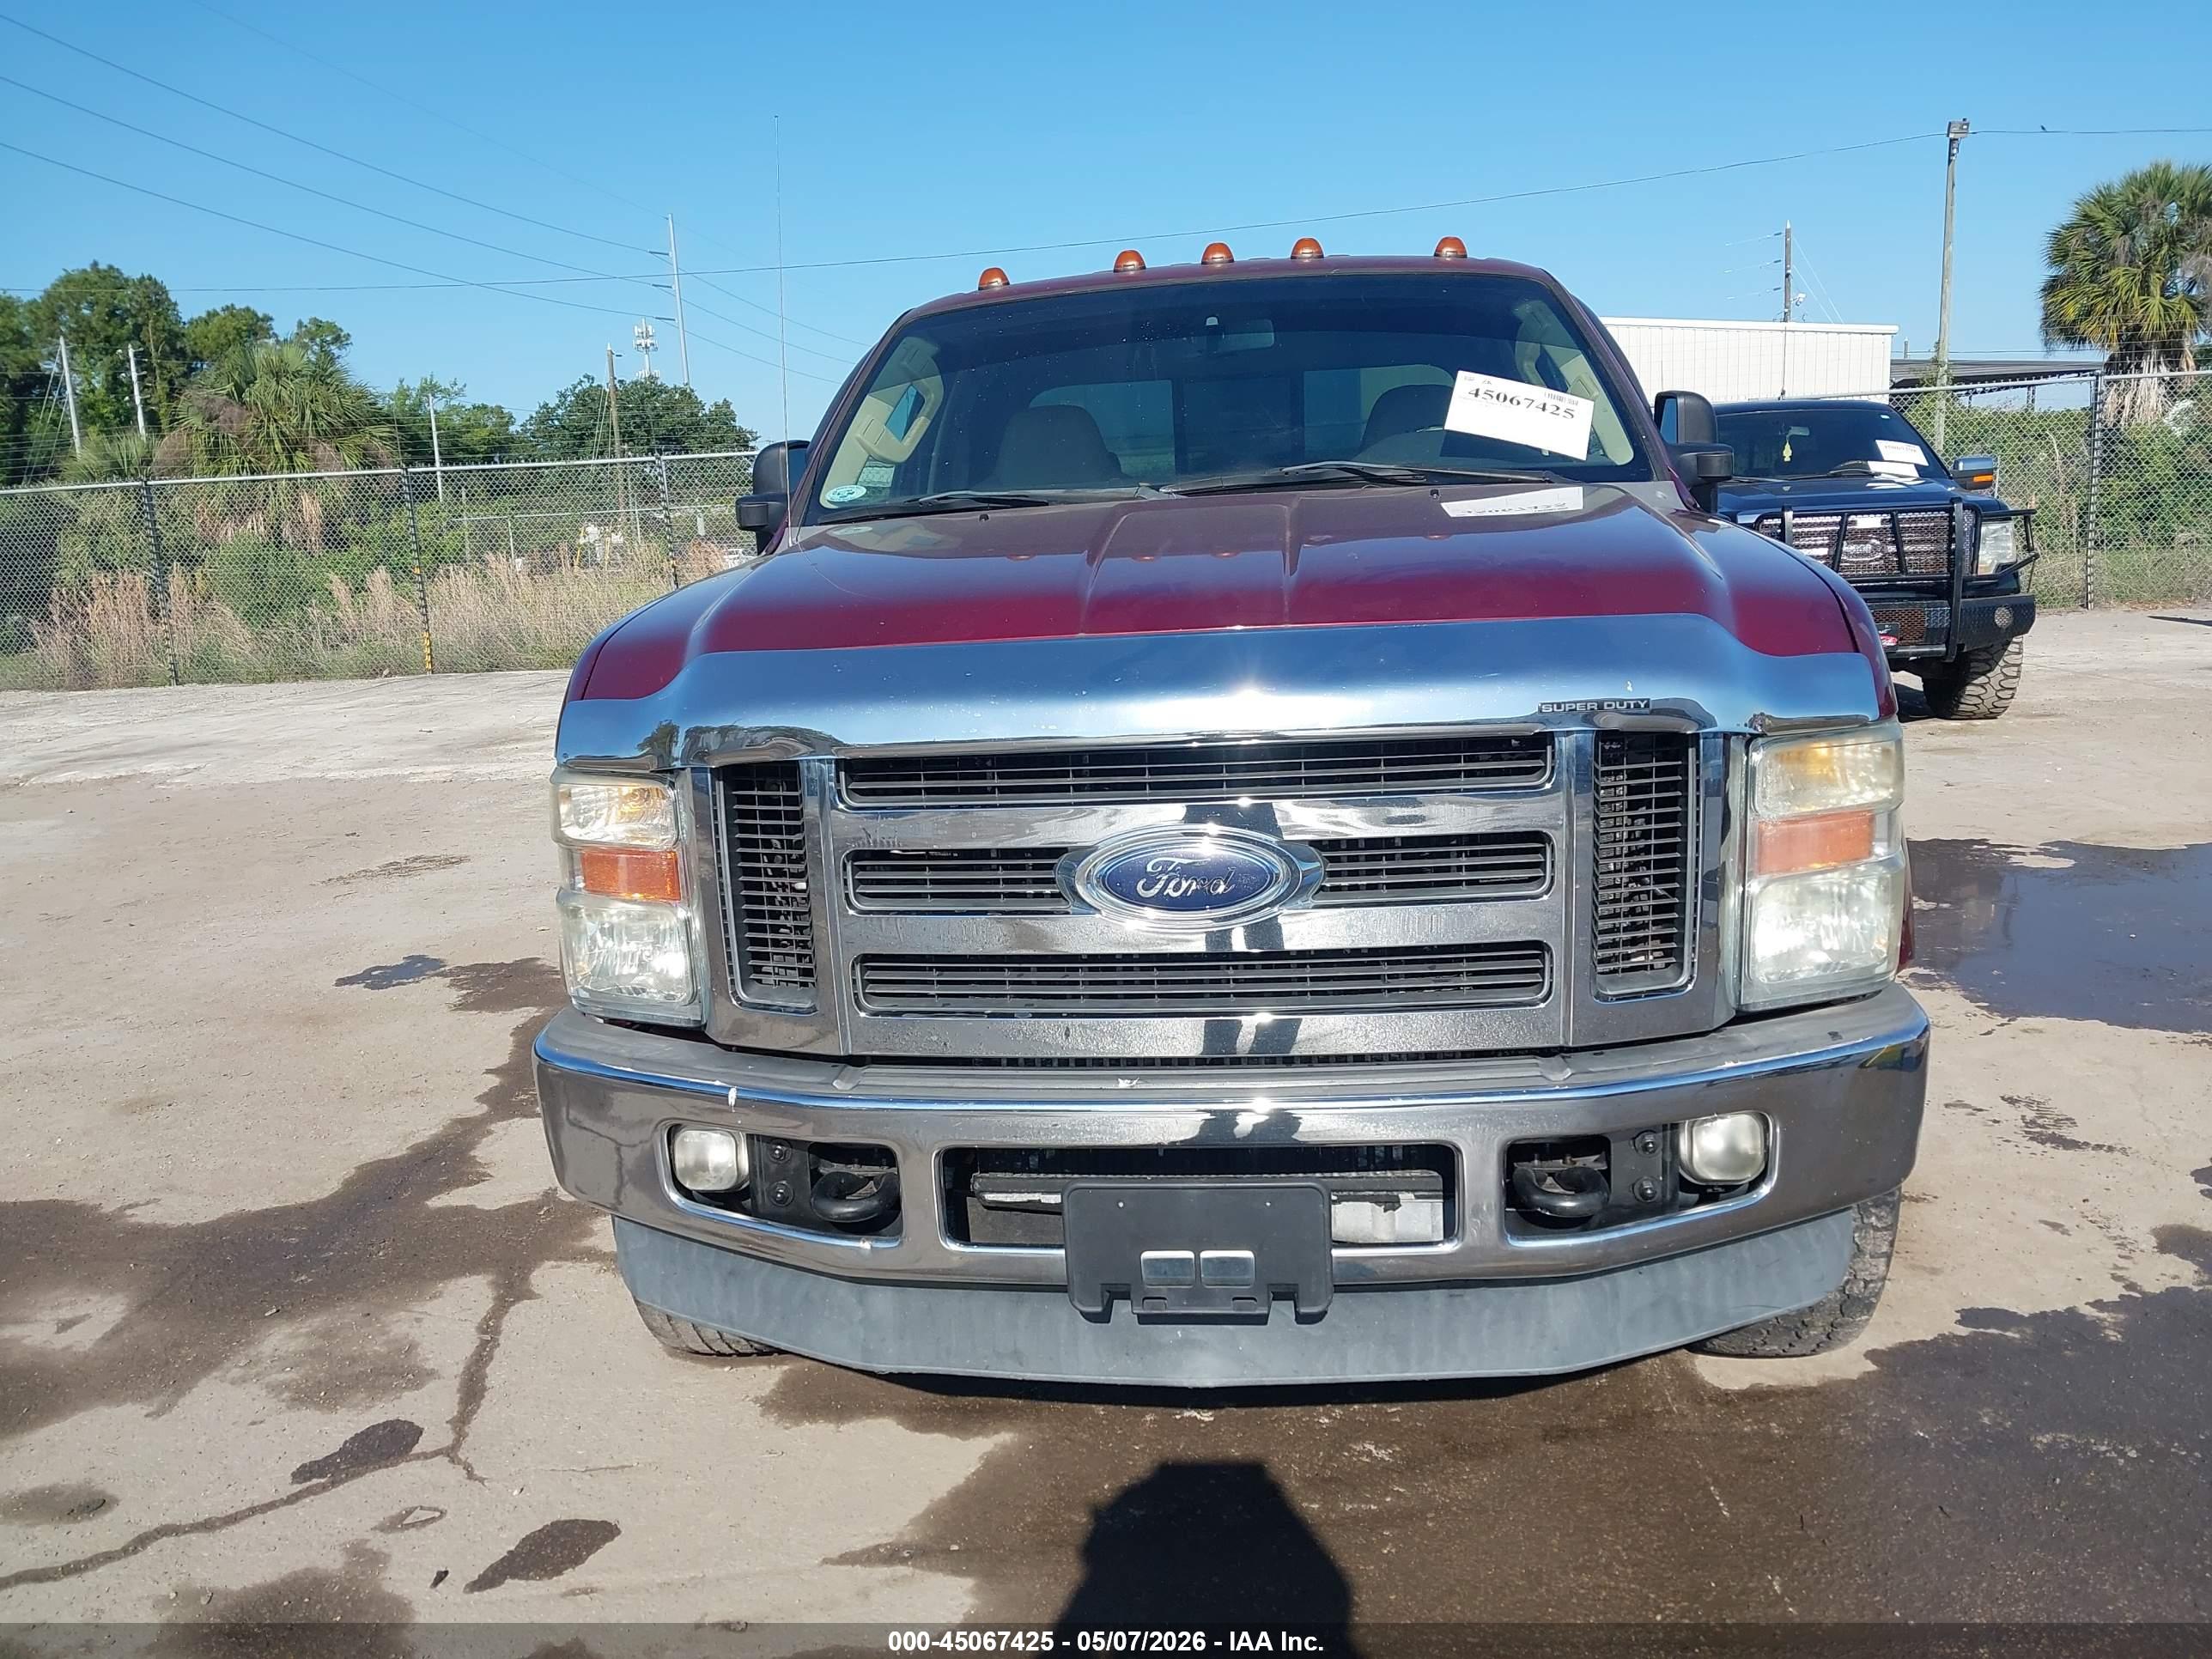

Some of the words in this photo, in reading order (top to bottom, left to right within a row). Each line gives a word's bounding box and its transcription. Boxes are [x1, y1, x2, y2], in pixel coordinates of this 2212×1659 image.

[1468, 387, 1576, 420] 45067425
[1541, 702, 1598, 713] SUPER
[1603, 700, 1648, 710] DUTY
[1136, 857, 1236, 898] Ford
